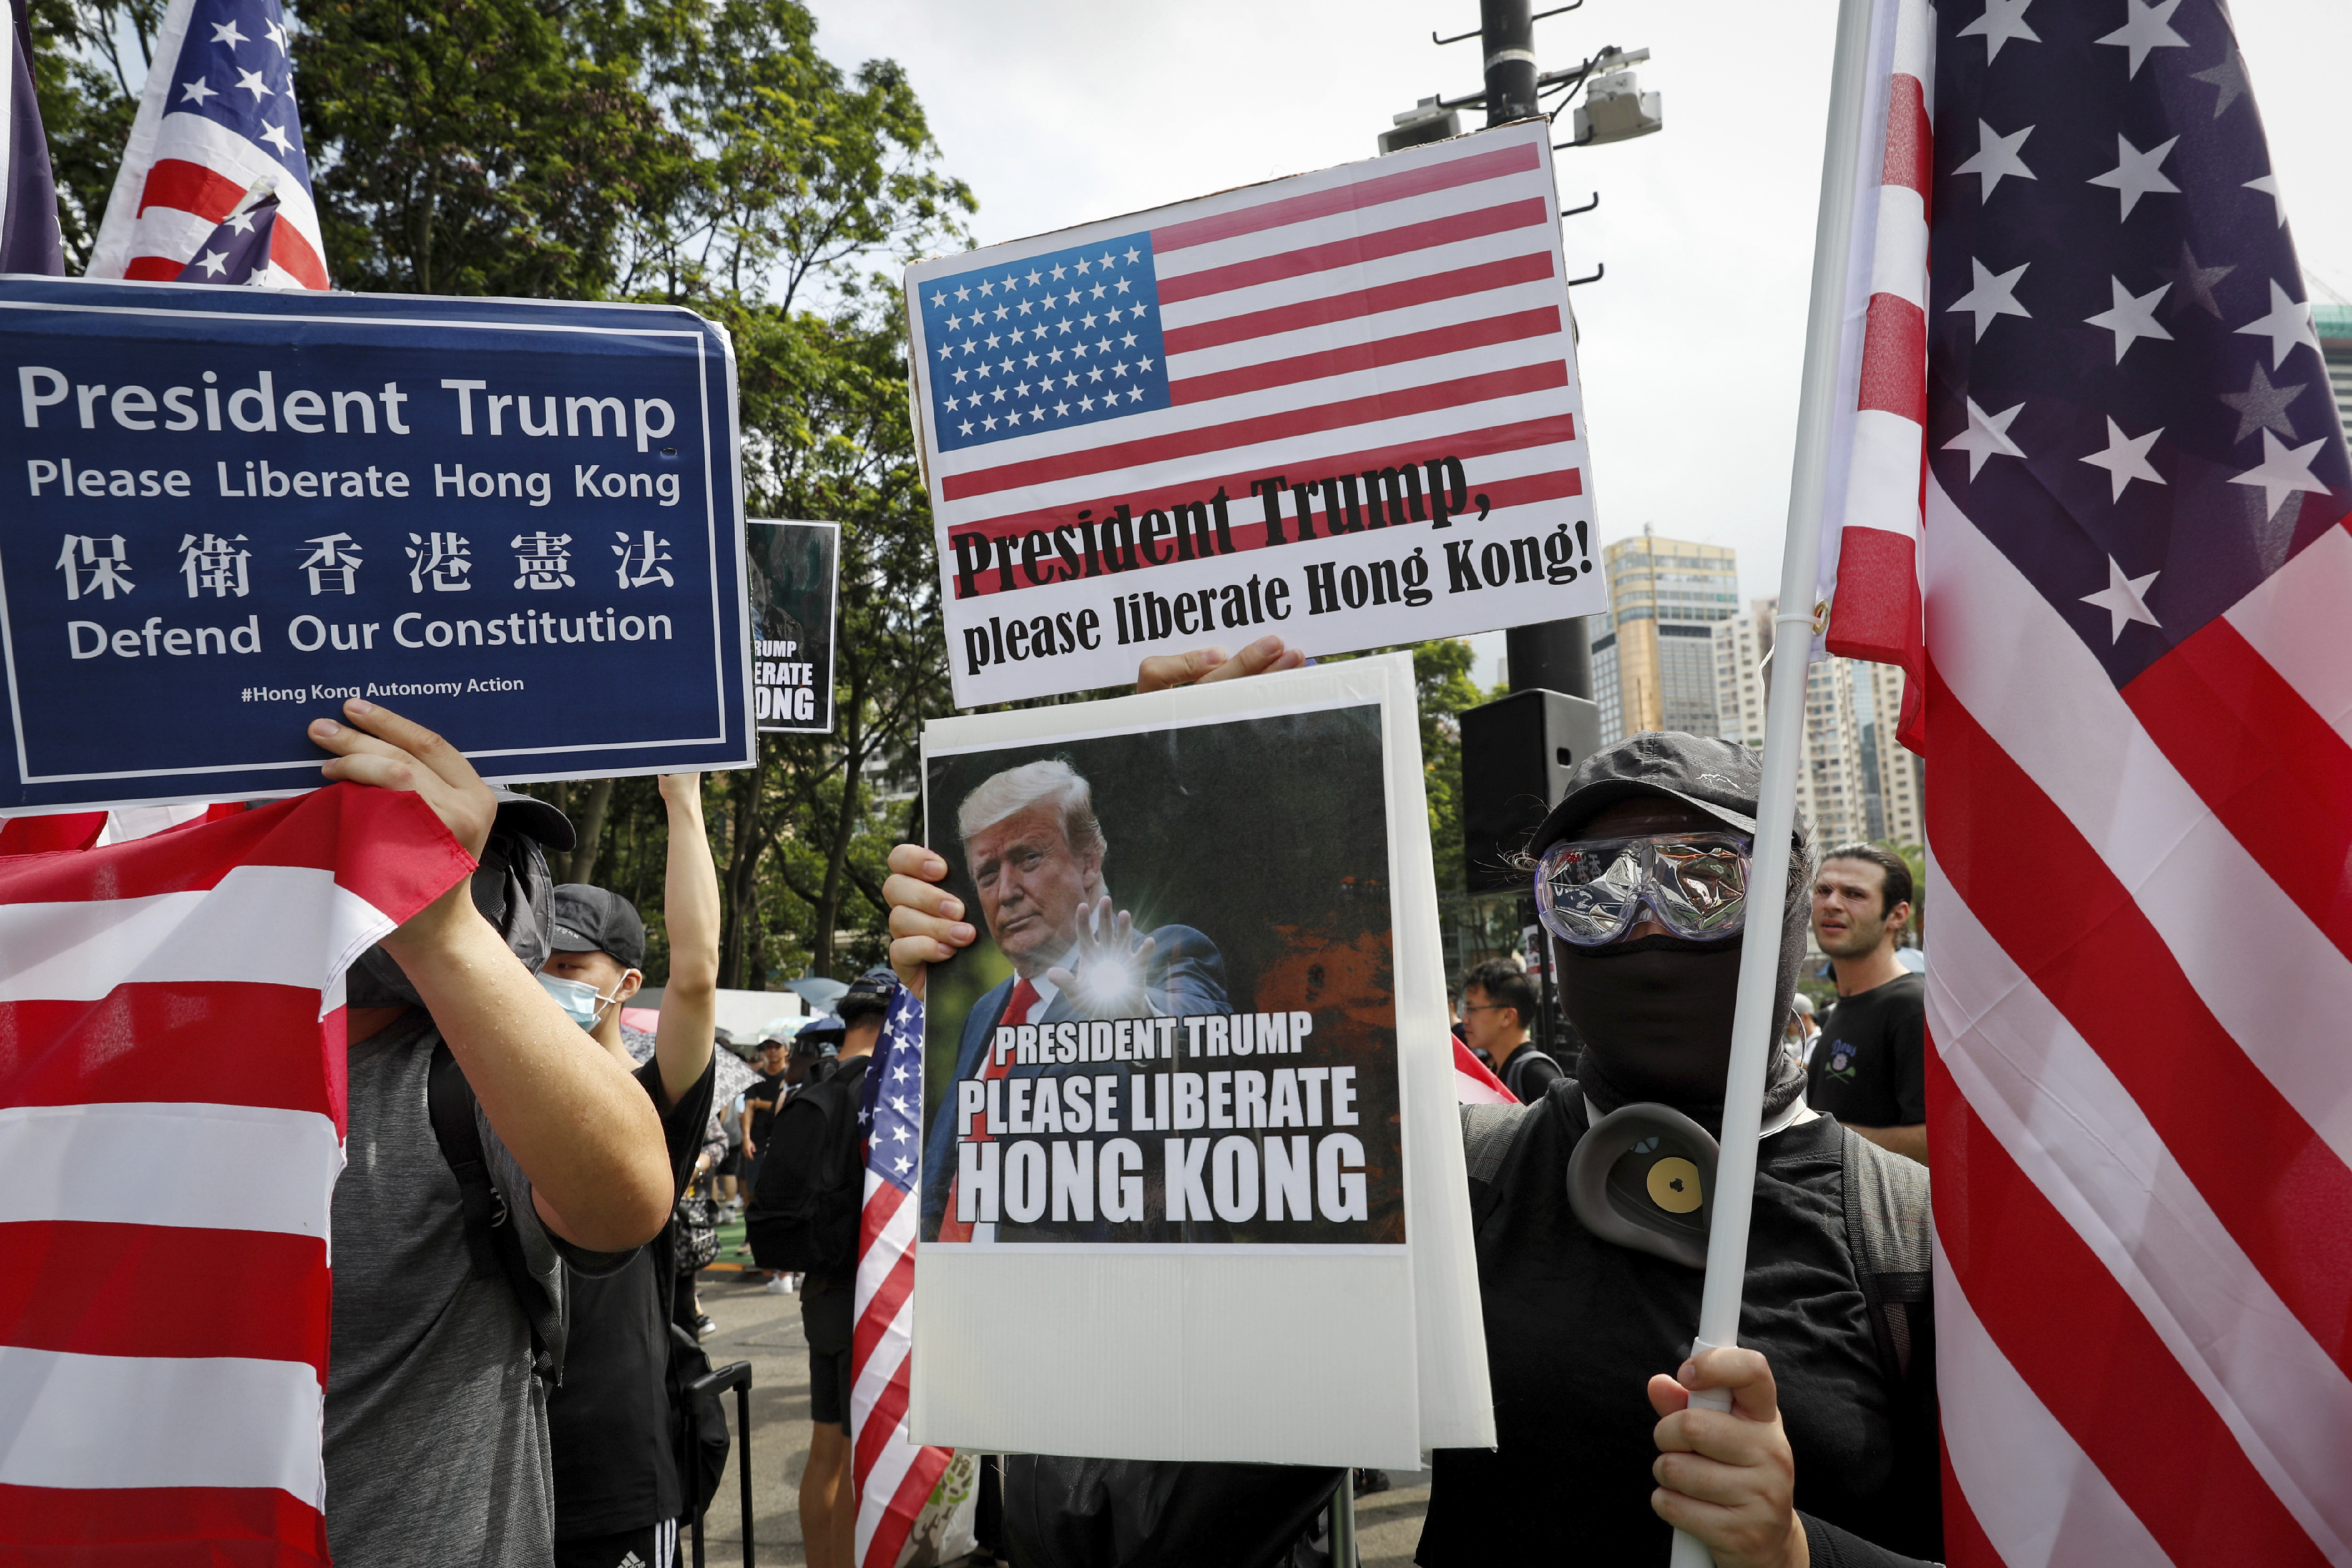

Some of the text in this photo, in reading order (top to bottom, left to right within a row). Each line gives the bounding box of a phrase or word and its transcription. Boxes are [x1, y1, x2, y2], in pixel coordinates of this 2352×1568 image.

[19, 367, 675, 452] President Trump
[28, 459, 680, 507] Please Liberate Hong Kong
[952, 456, 1490, 600] President Trump,
[56, 531, 674, 600] 保衛香港憲法
[963, 521, 1592, 676] please liberate Hong Kong!
[68, 607, 672, 659] Defend Our Constitution
[755, 640, 797, 657] RUMP
[241, 677, 524, 704] #Hong Kong Autonomy Action
[755, 661, 813, 685] ERATE
[755, 686, 814, 720] ONG
[996, 1011, 1312, 1065] PRESIDENT TRUMP
[958, 1067, 1359, 1134] PLEASE LIBERATE
[958, 1133, 1367, 1223] HONG KONG
